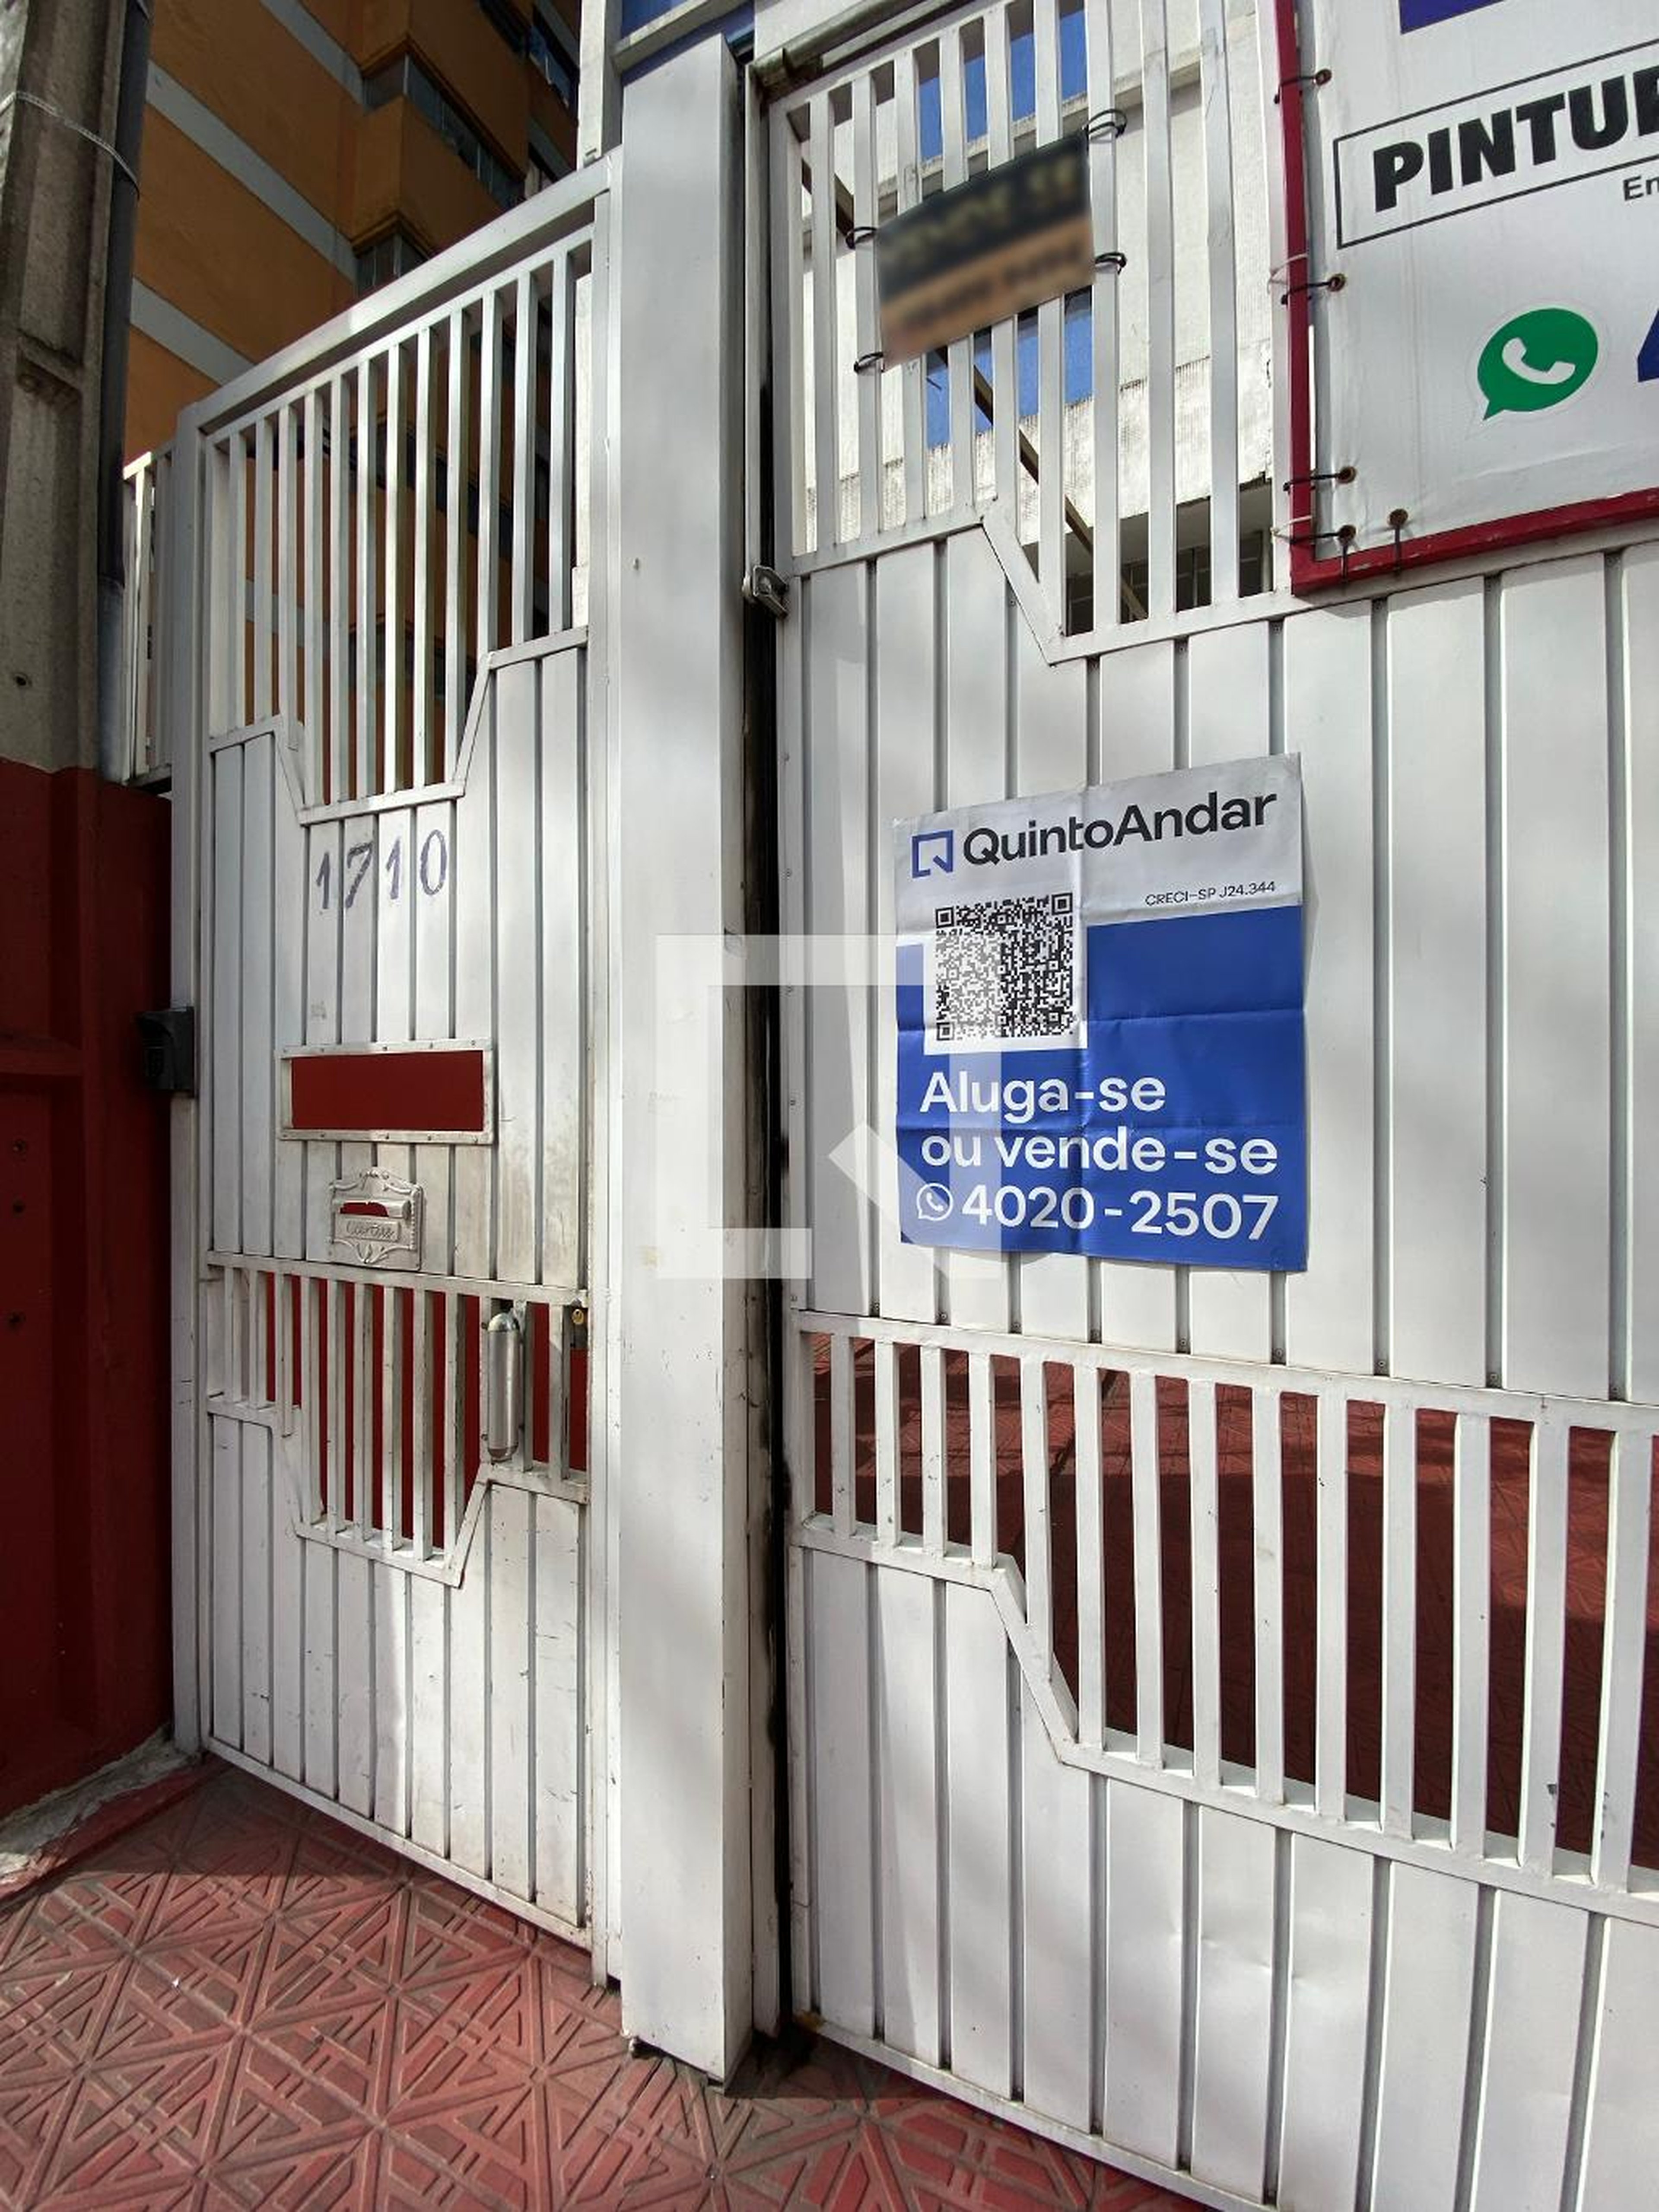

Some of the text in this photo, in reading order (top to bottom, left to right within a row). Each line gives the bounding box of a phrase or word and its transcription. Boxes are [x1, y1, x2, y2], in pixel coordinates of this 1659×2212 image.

[963, 791, 1278, 866] QuintoAndar
[316, 829, 448, 910] 1710
[1145, 881, 1275, 906] CRECI-SP J24.344
[919, 1071, 1166, 1124] Aluga-se
[921, 1126, 1278, 1174] ou vende-se
[962, 1184, 1279, 1240] 4020-2507
